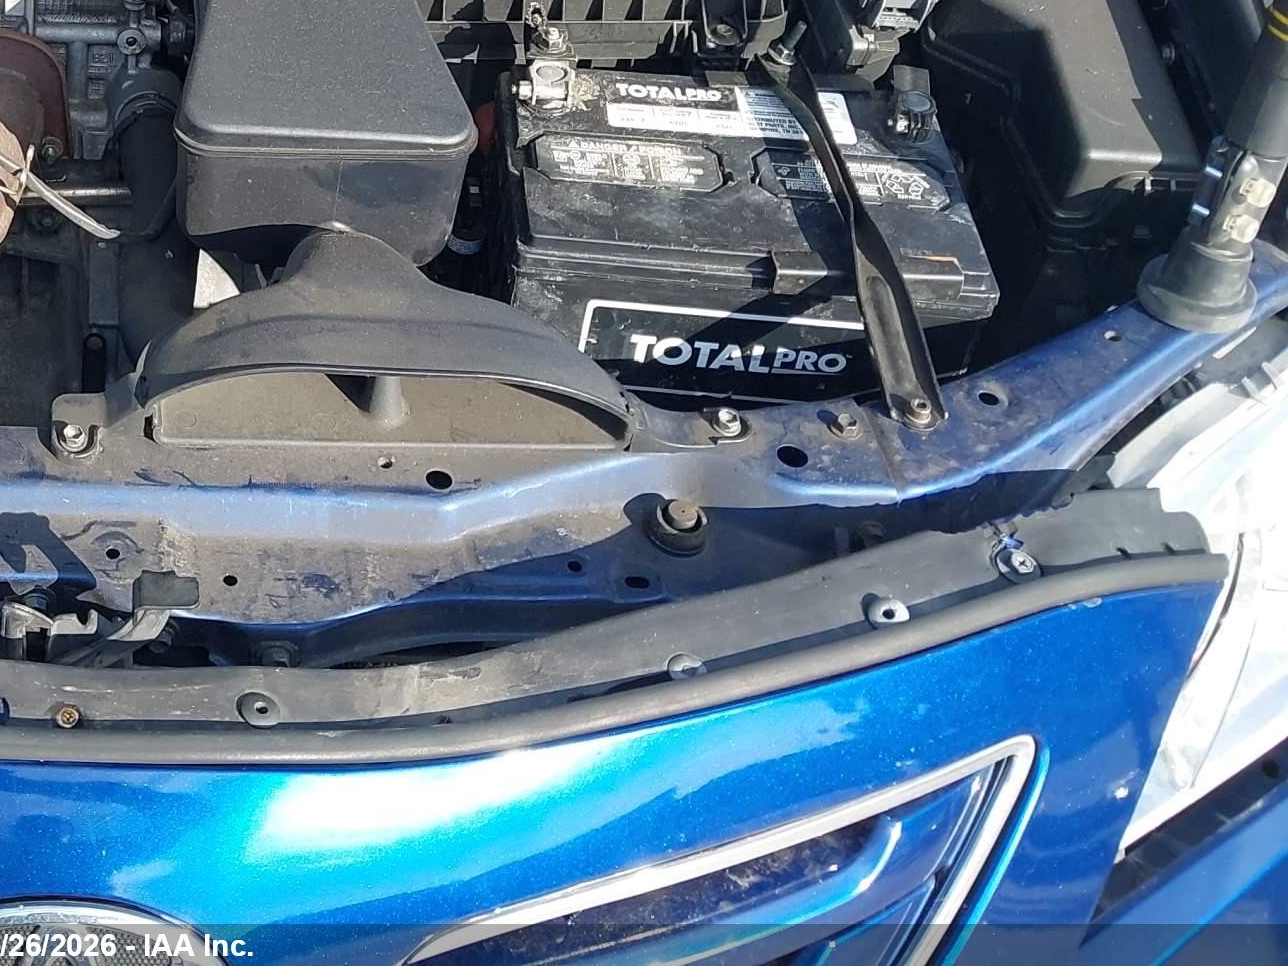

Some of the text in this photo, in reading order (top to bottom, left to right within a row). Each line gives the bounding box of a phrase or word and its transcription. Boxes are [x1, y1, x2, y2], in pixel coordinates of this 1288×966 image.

[615, 82, 722, 101] TOTALPRO
[580, 142, 627, 152] DANGER
[629, 334, 847, 374] TOTALPRO
